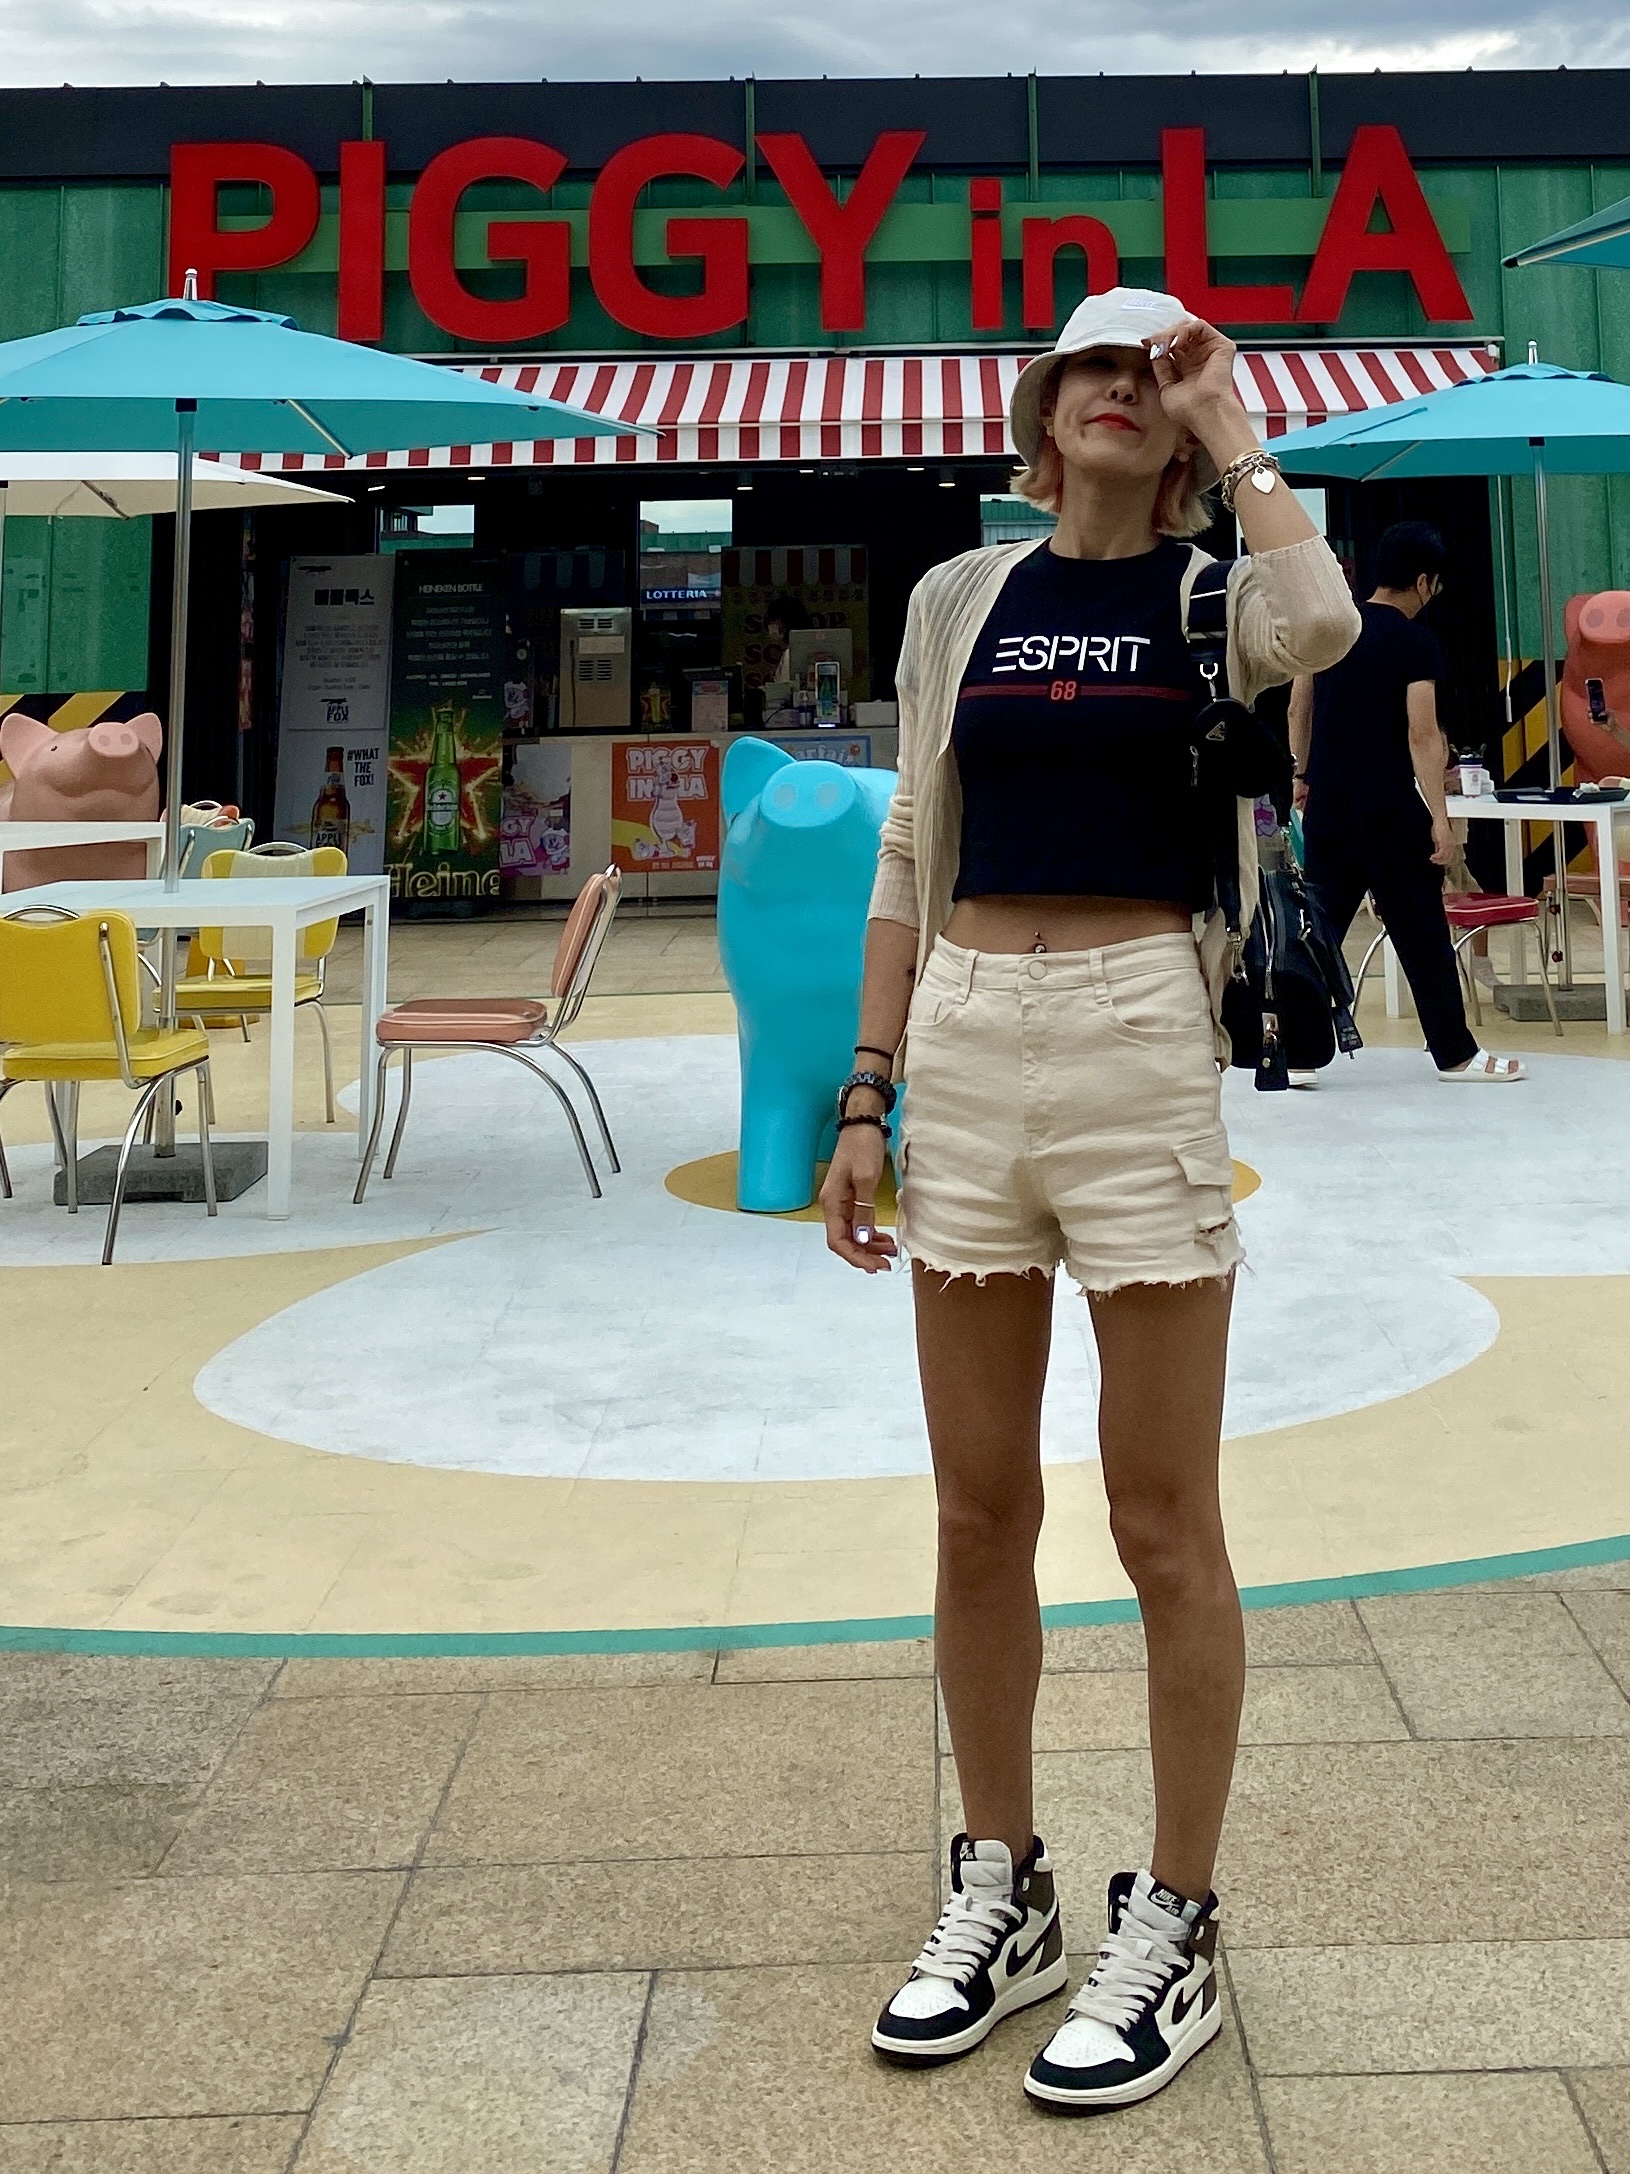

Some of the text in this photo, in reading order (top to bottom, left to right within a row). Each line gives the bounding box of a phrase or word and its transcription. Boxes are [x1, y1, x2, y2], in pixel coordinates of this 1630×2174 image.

[168, 123, 1475, 343] PIGGY in LA
[645, 589, 708, 601] LOTTERIA
[992, 635, 1151, 673] ESPRIT
[1050, 680, 1077, 701] 68
[347, 748, 380, 761] #WHAT
[627, 747, 708, 773] PIGGY
[354, 762, 372, 774] THE
[354, 774, 375, 788] FOX!
[627, 773, 708, 801] IN LA
